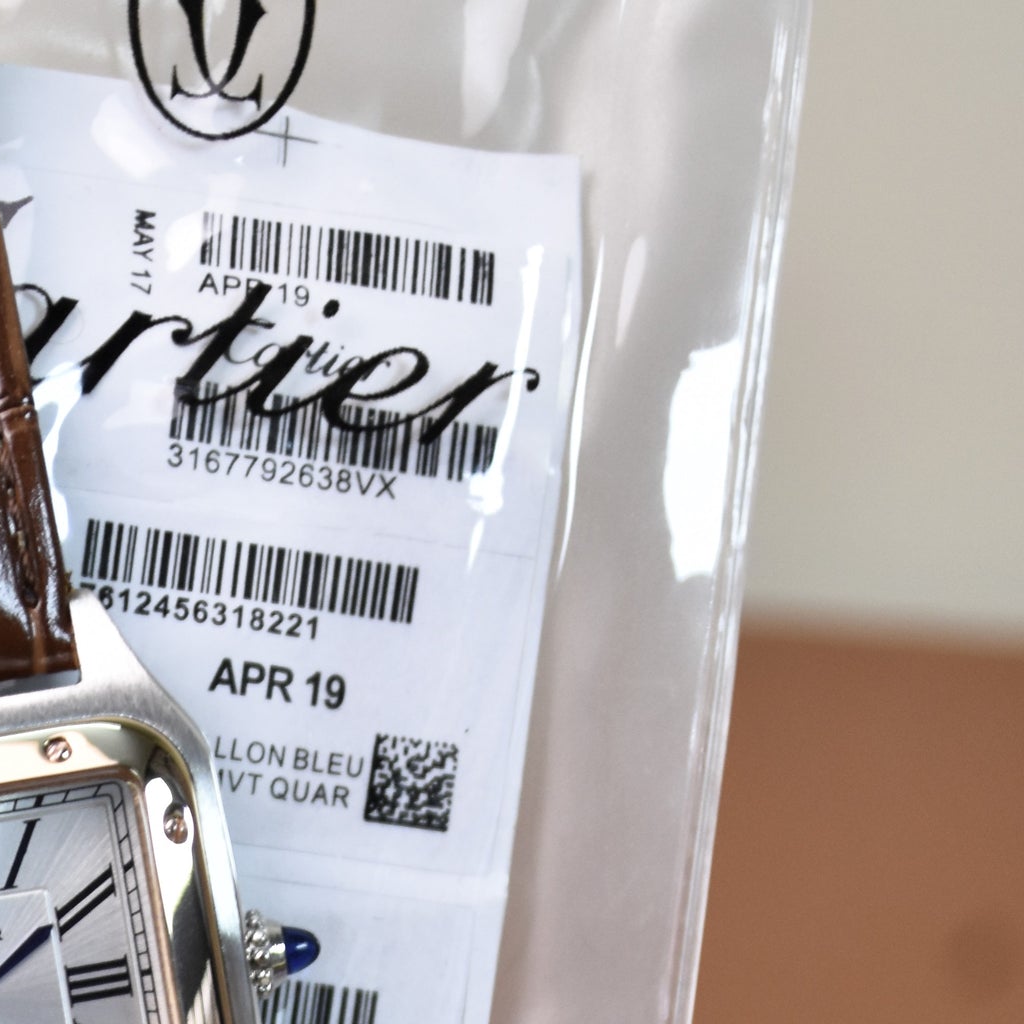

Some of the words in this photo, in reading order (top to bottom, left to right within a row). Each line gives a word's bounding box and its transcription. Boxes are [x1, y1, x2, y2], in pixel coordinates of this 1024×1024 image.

[133, 208, 156, 262] MAY
[130, 269, 152, 295] 17
[278, 282, 310, 307] 19
[12, 280, 540, 447] artier
[167, 443, 397, 500] 3167792638VX
[208, 657, 294, 703] APR
[305, 672, 347, 710] 19
[292, 746, 364, 778] BLEU
[270, 776, 349, 809] QUAR
